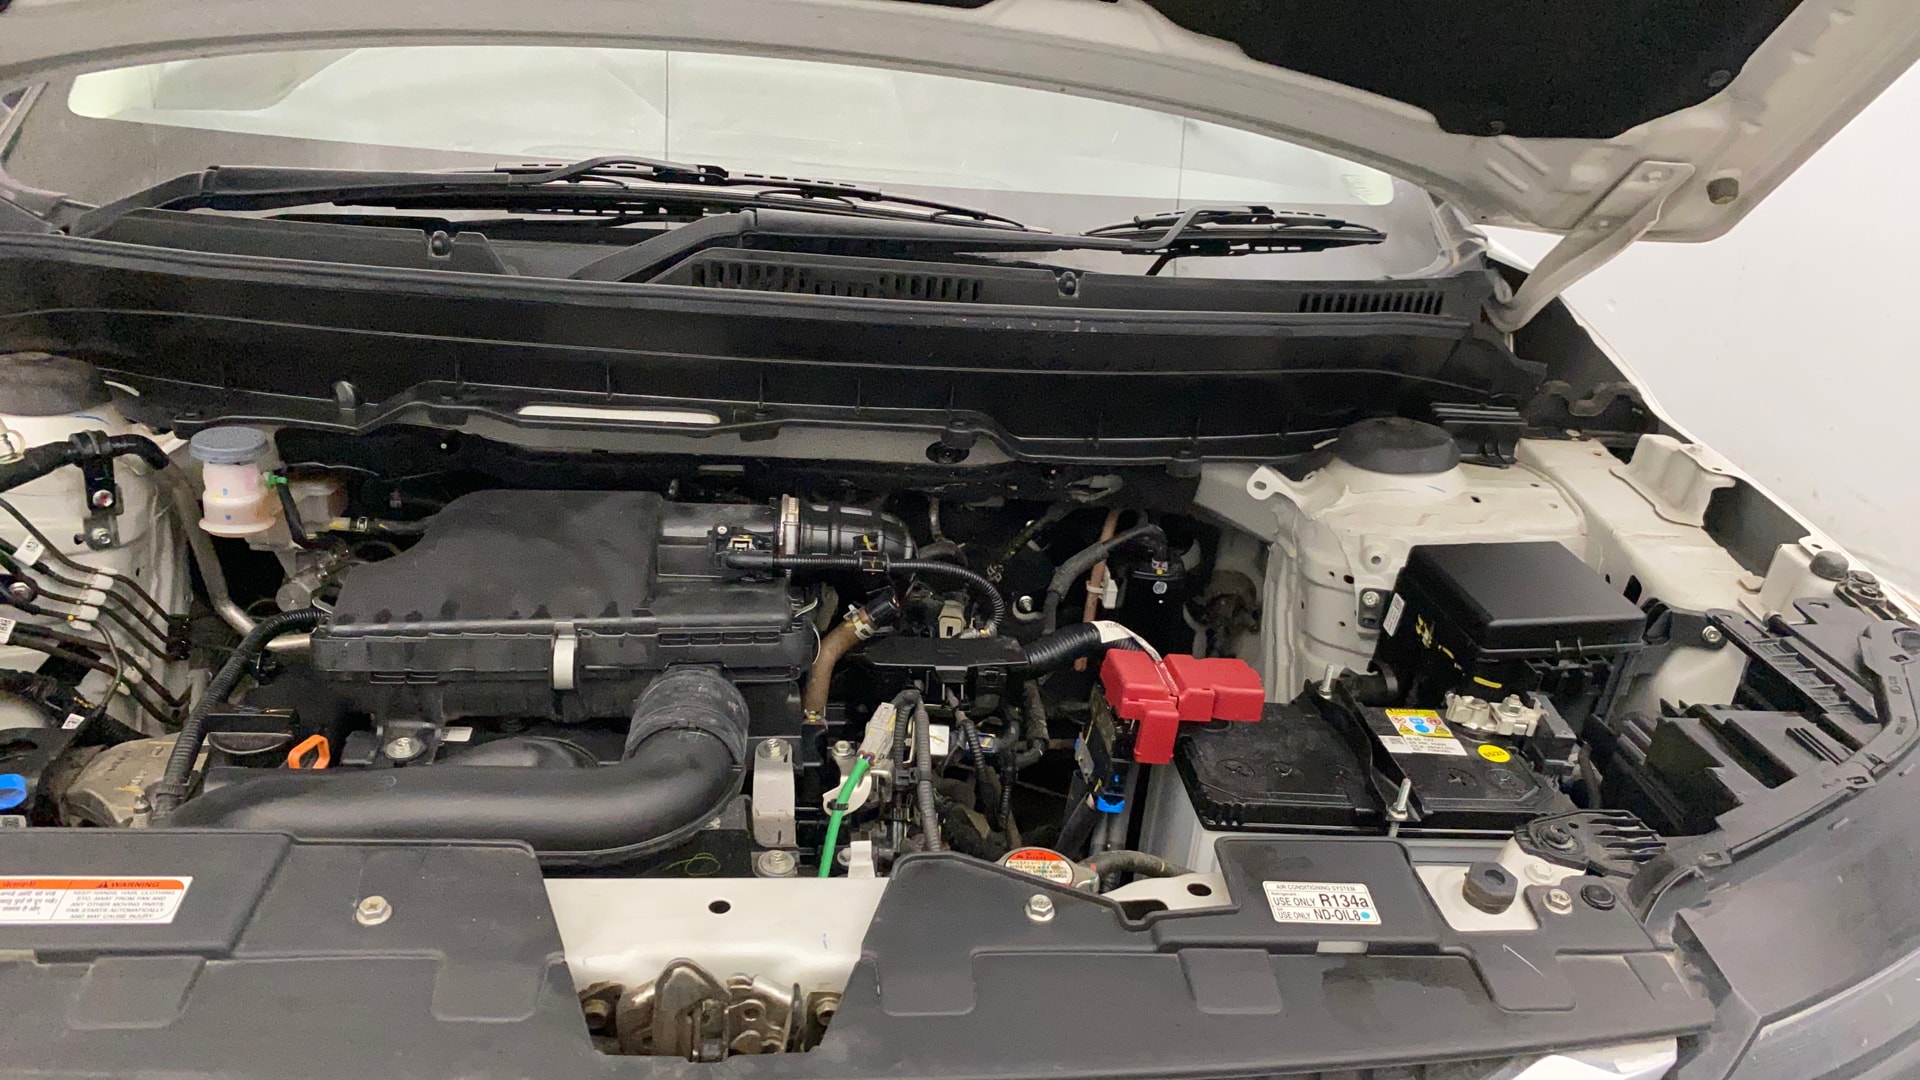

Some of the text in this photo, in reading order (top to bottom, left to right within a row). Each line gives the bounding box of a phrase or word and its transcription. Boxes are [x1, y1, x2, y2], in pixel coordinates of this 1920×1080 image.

[1272, 893, 1369, 908] USE ONLY R134a
[1279, 908, 1361, 921] USE ONLY ND-OIL8
